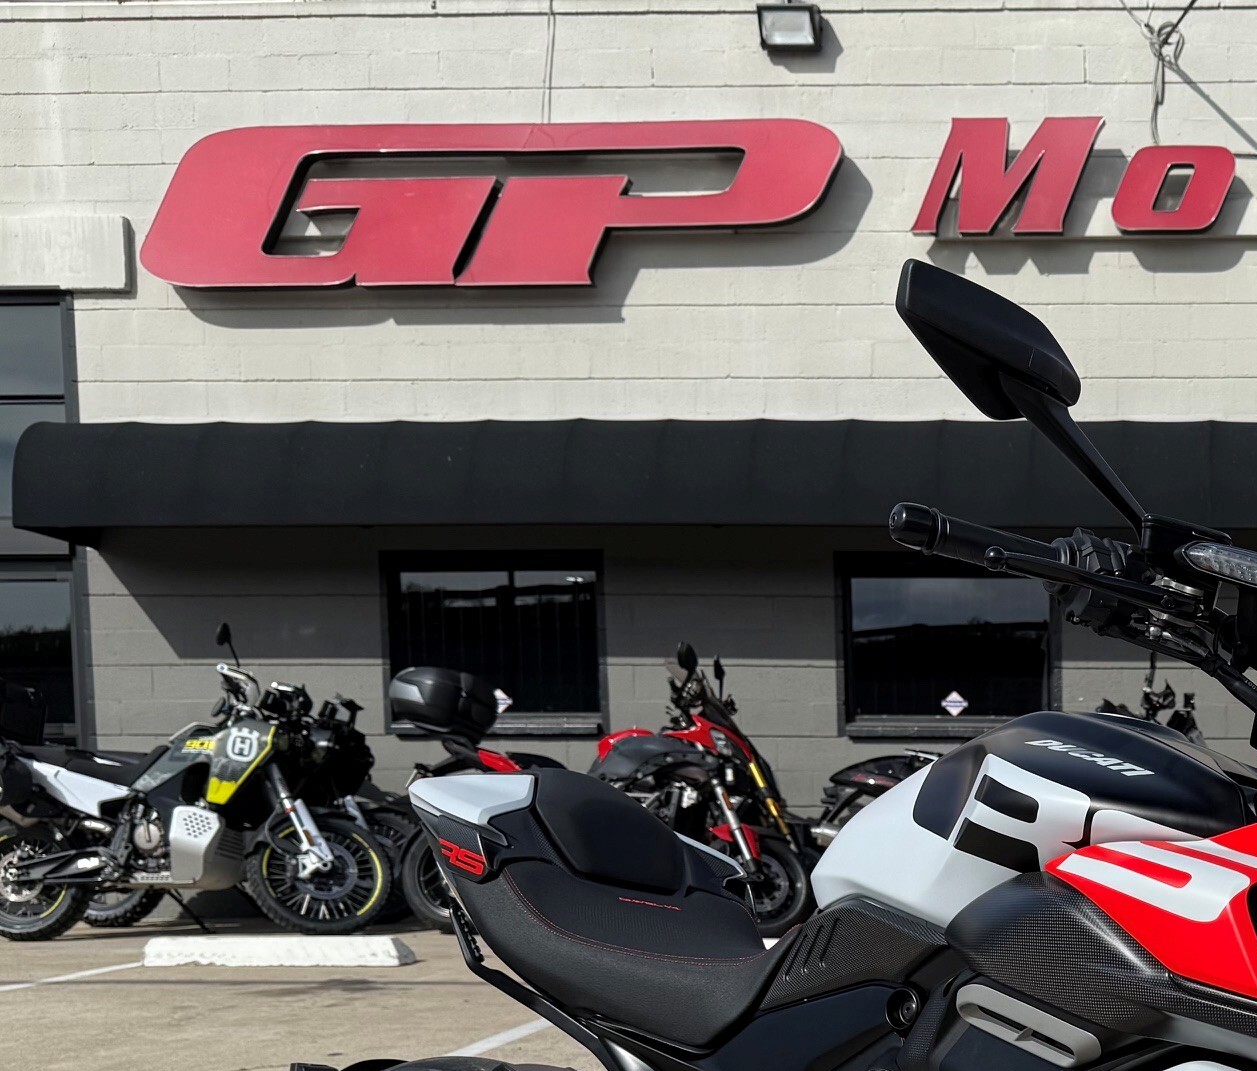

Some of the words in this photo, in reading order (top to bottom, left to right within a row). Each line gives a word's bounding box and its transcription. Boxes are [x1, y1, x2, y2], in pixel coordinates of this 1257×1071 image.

[140, 117, 843, 289] GP
[1024, 739, 1156, 777] DUCATI
[438, 836, 486, 876] RS
